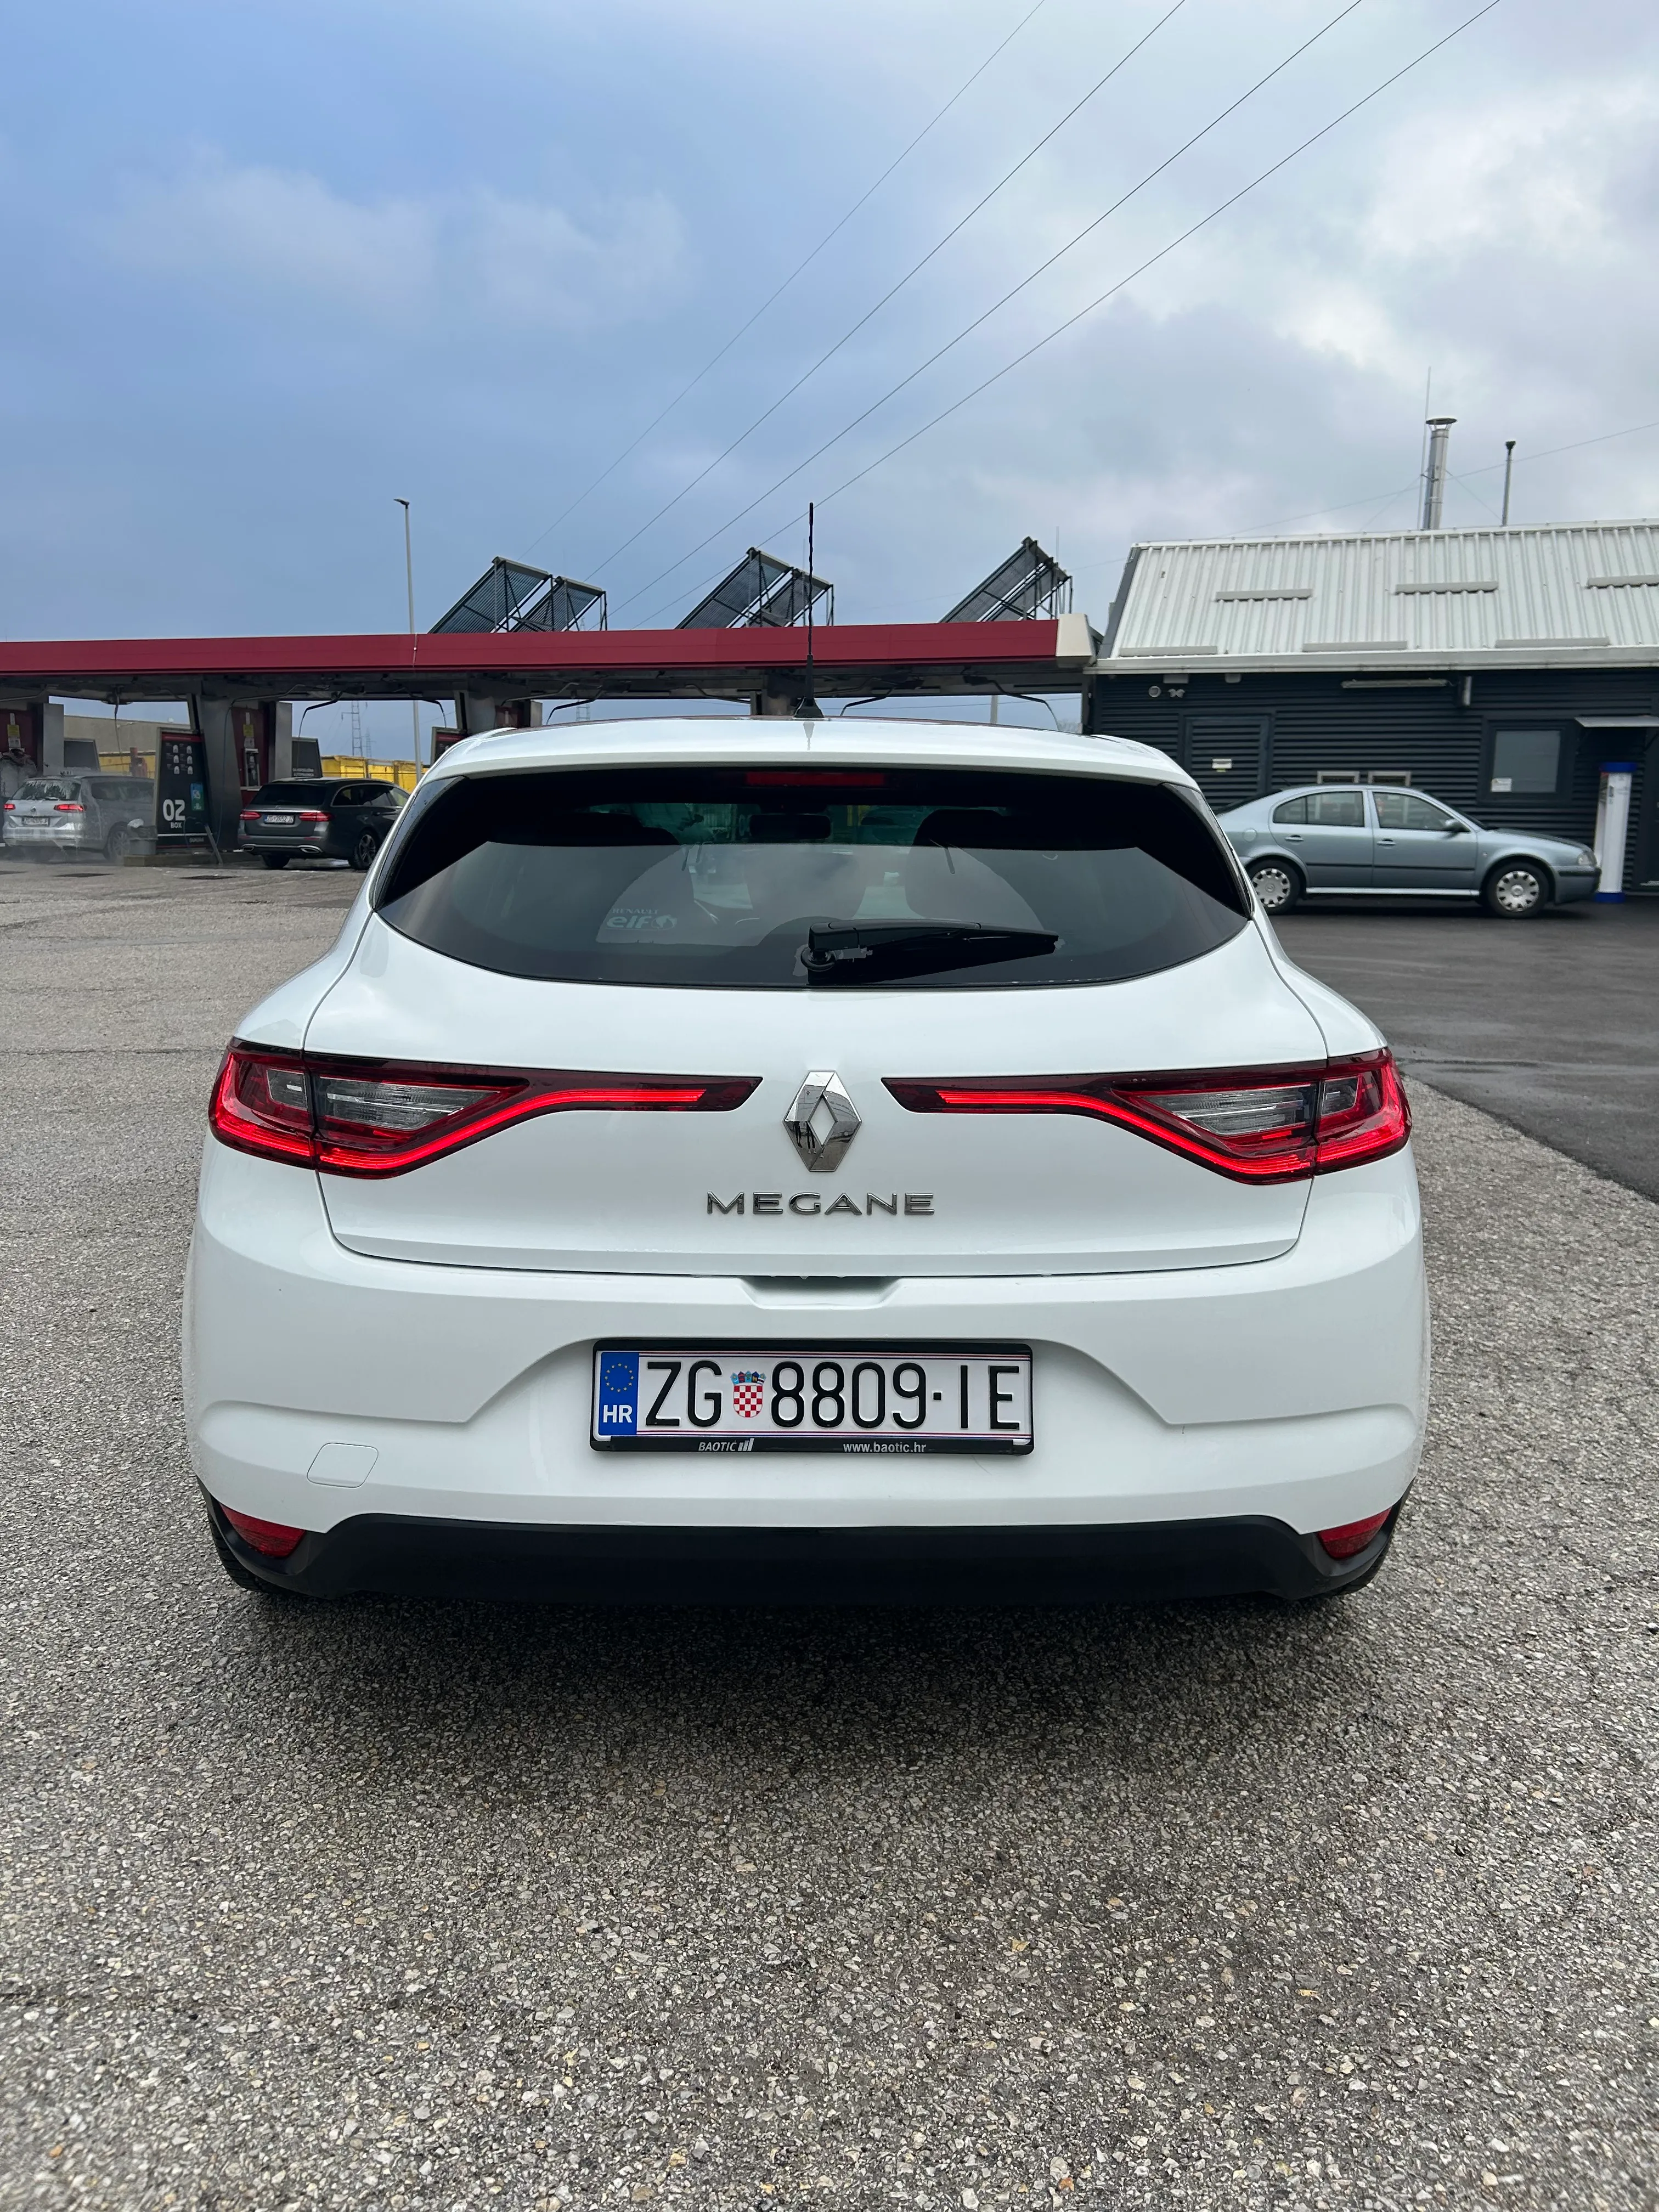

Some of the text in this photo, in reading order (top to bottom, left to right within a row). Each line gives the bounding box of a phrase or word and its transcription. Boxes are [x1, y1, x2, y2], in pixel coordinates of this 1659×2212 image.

[162, 799, 185, 821] 02
[607, 915, 652, 928] elf
[707, 1192, 934, 1215] MEGANE
[646, 1360, 722, 1427] ZG
[603, 1404, 633, 1423] HR
[843, 1442, 927, 1453] www.baotic.hr
